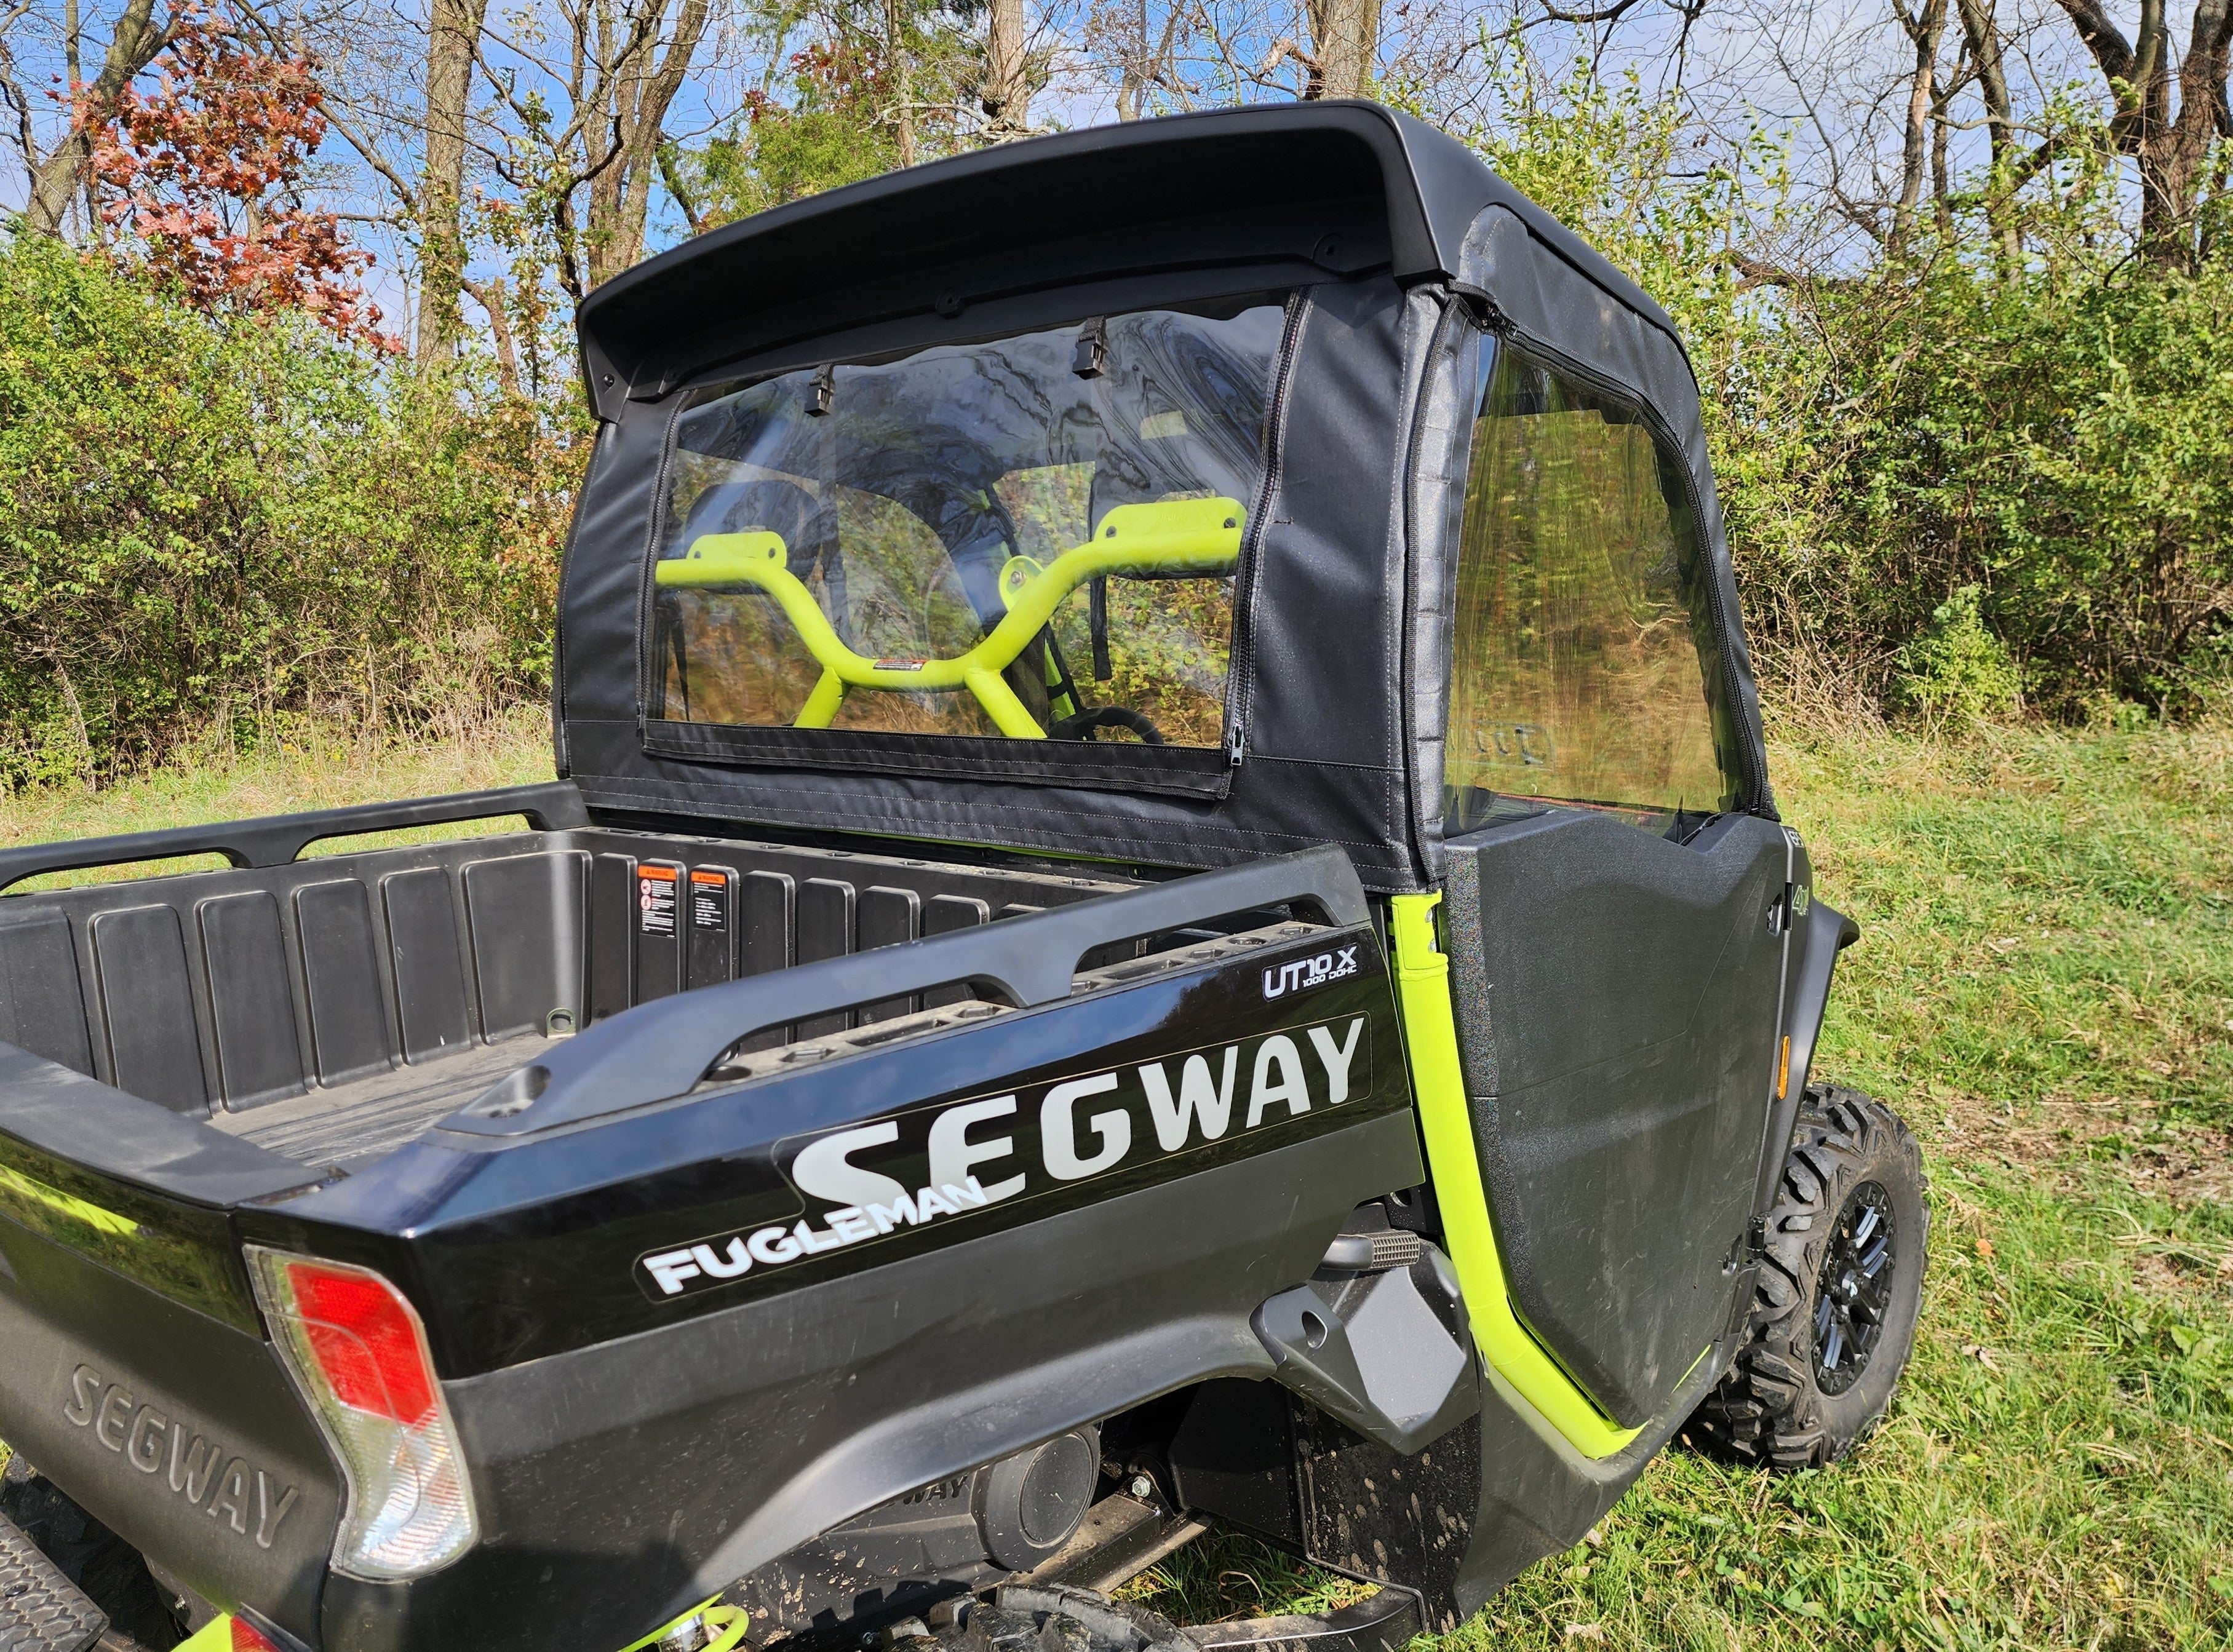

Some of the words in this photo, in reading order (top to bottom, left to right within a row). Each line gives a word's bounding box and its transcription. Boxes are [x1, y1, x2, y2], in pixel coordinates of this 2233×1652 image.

[1265, 954, 1332, 998] UT10
[1337, 946, 1357, 969] X
[1302, 974, 1326, 988] 1000
[1329, 964, 1357, 980] DOHC
[792, 1017, 1364, 1249] SEGWAY
[643, 1175, 988, 1295] FUGLEMAN
[63, 1363, 300, 1549] SEGWAY
